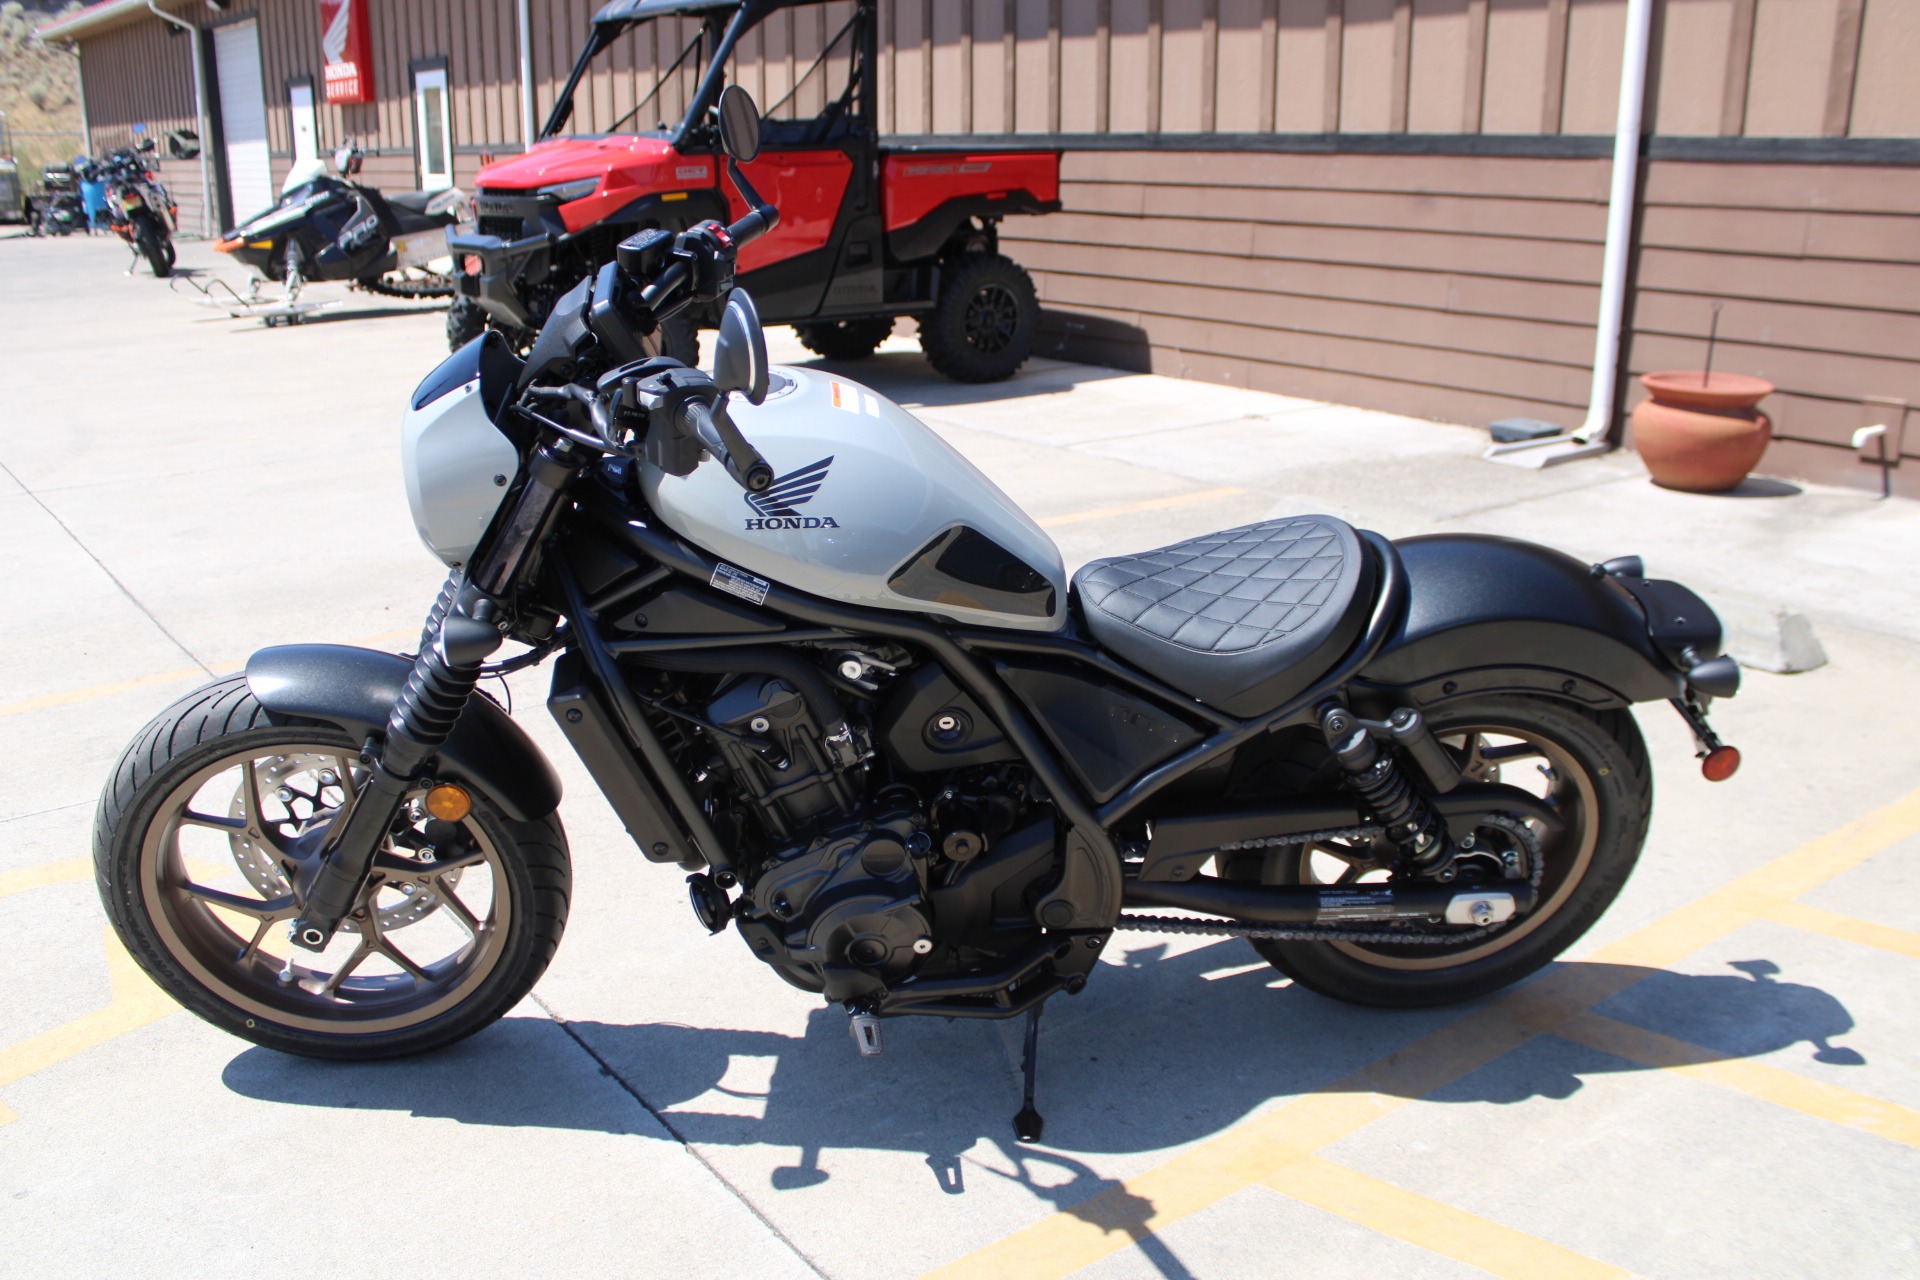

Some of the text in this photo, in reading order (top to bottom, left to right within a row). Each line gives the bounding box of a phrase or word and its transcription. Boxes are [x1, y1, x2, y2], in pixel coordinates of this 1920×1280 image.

[324, 62, 358, 80] HONDA
[326, 78, 359, 98] SERVICE
[744, 516, 840, 531] HONDA
